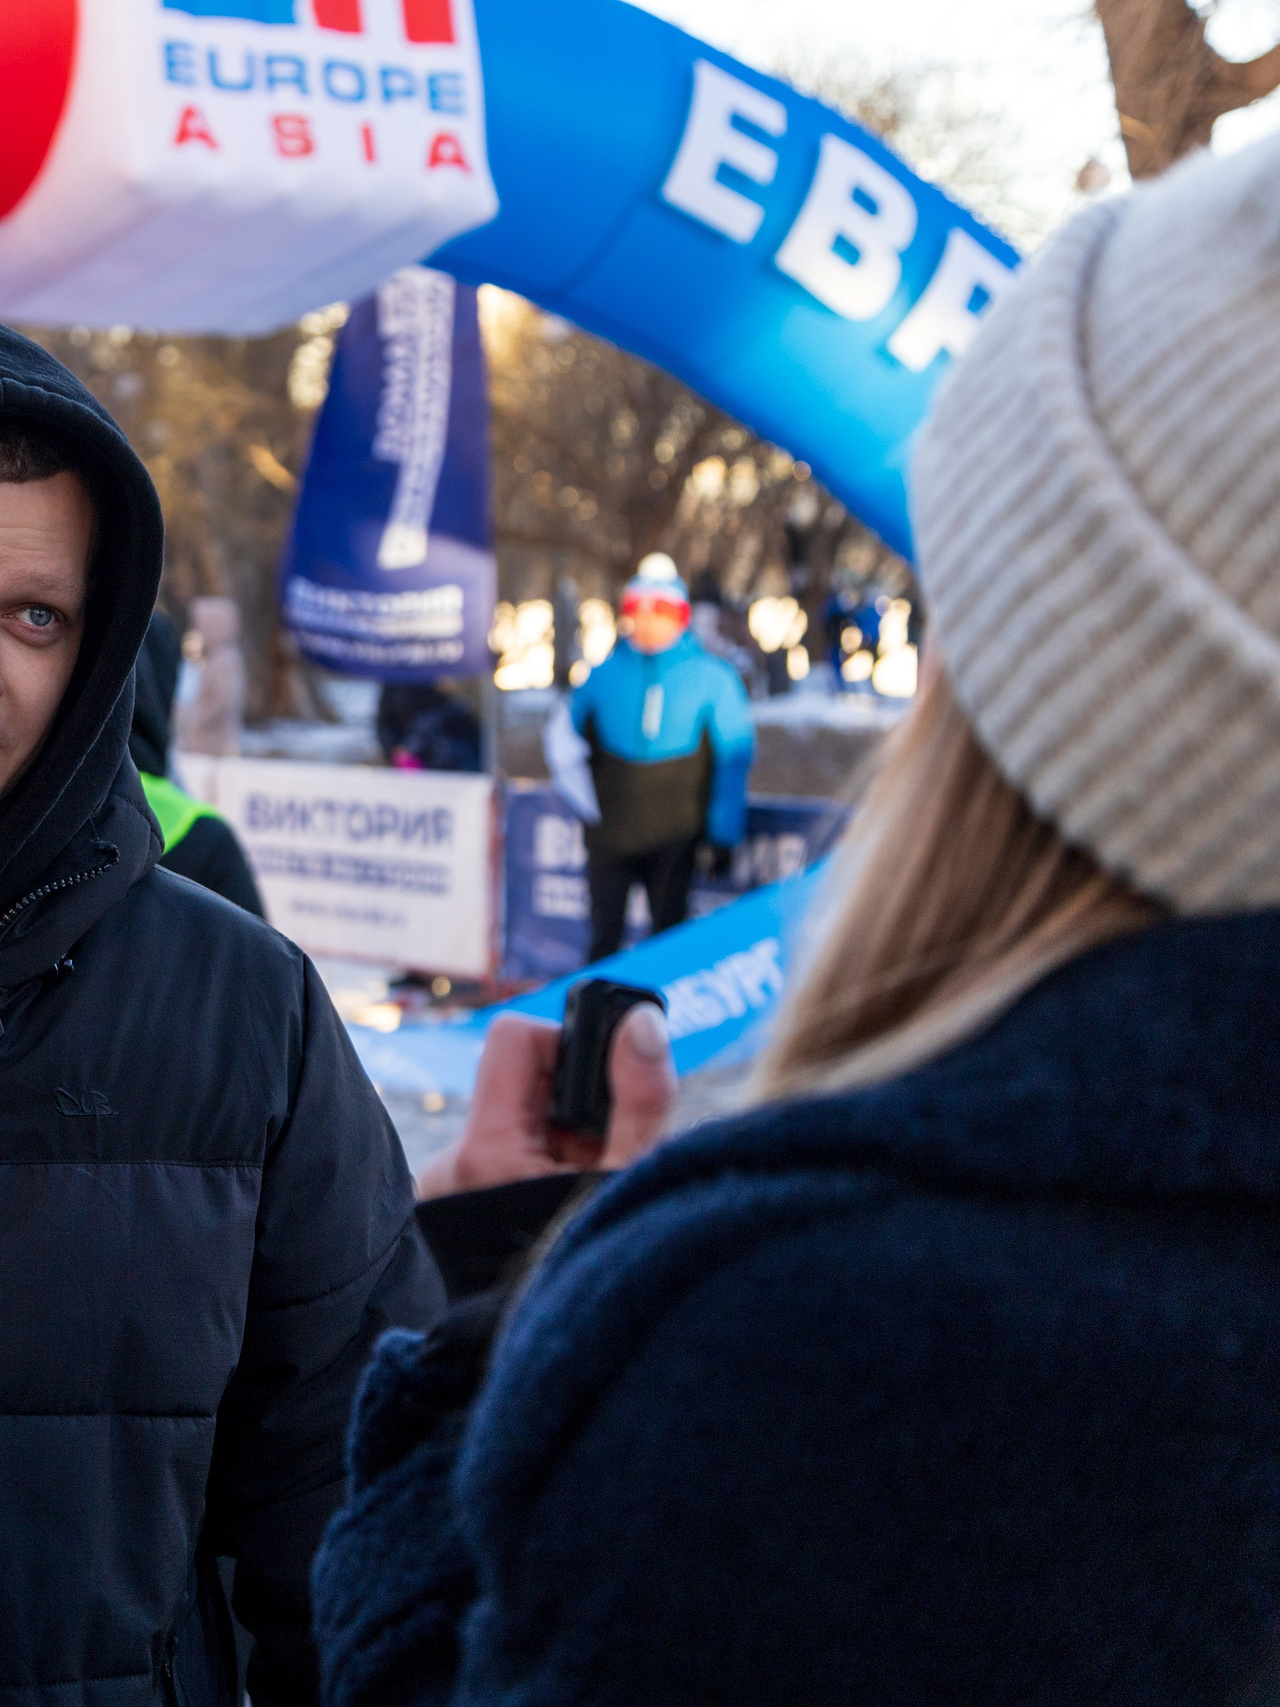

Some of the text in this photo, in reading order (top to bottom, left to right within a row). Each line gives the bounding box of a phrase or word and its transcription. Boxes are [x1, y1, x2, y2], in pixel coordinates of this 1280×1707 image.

[162, 38, 468, 118] EUROPE
[173, 104, 474, 174] ASIA
[245, 790, 455, 848] ВИКТОРИЯ
